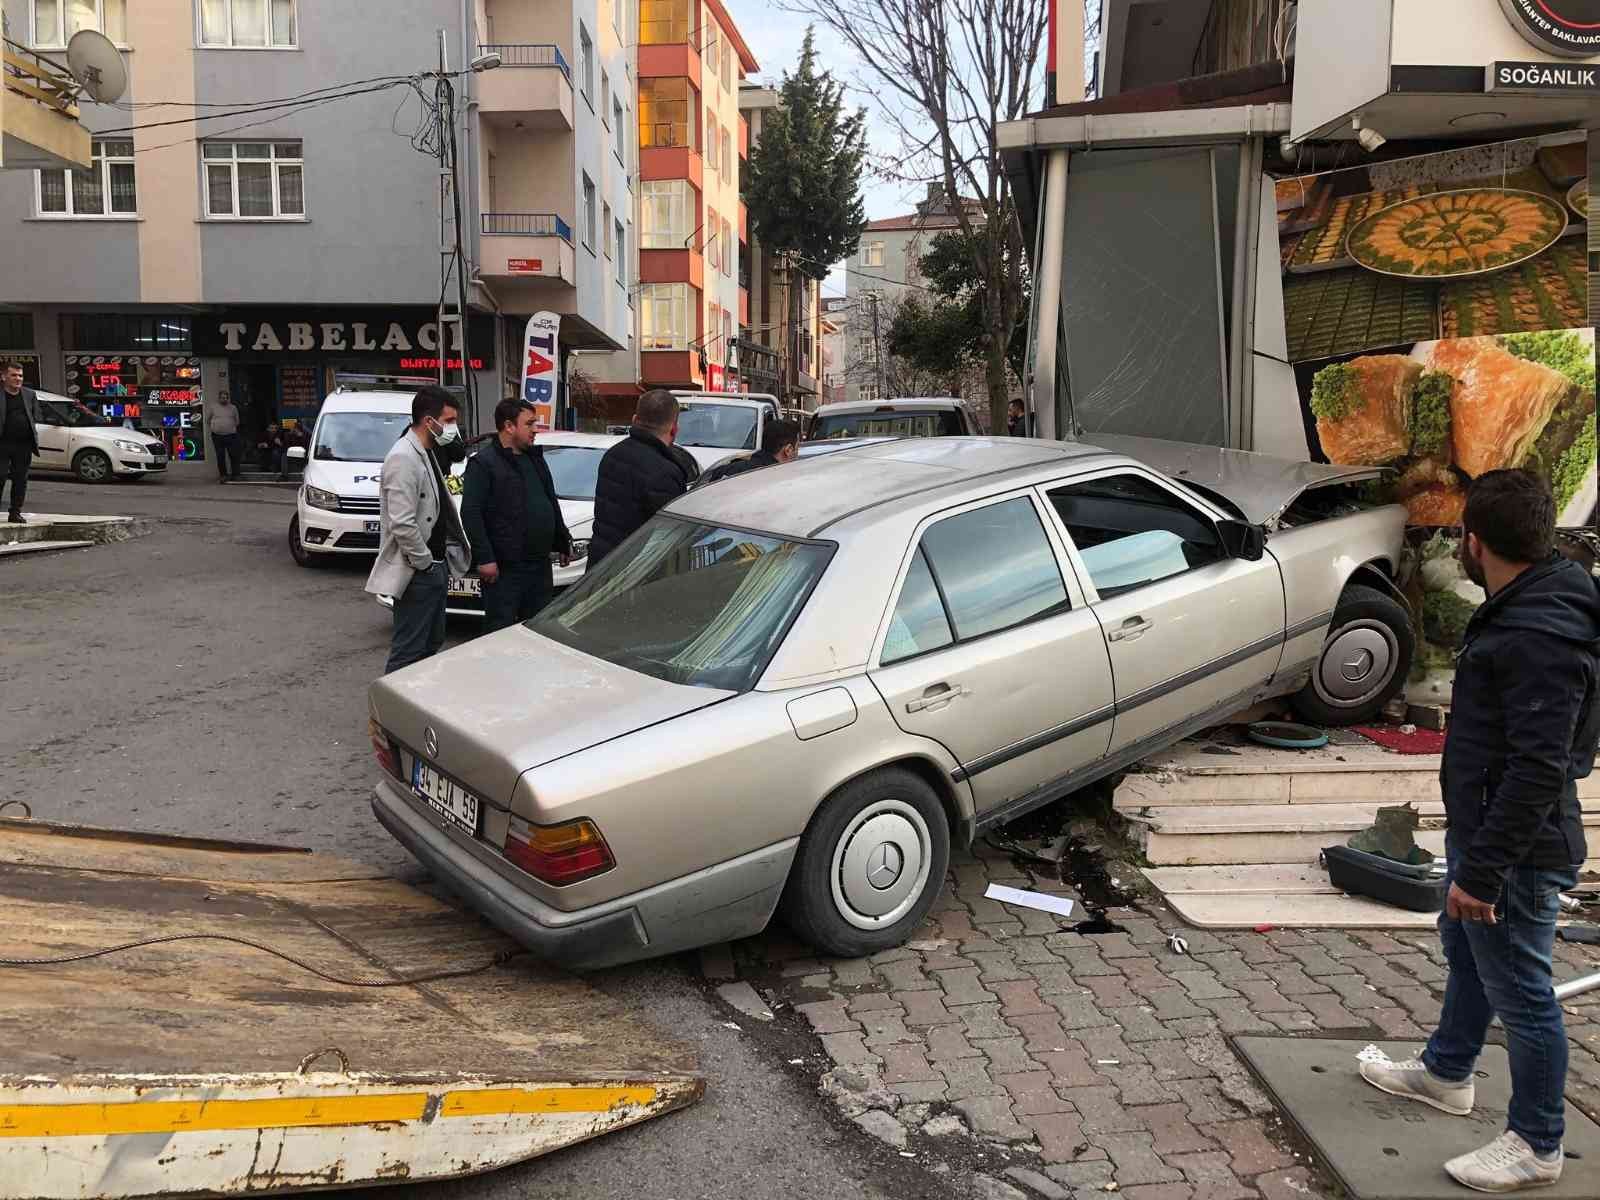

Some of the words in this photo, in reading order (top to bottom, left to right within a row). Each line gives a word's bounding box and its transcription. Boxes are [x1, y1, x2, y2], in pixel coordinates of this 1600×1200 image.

[1500, 65, 1595, 85] SOĞANLIK
[219, 322, 463, 351] TABELACI
[437, 773, 455, 810] EJA
[463, 791, 477, 824] 59
